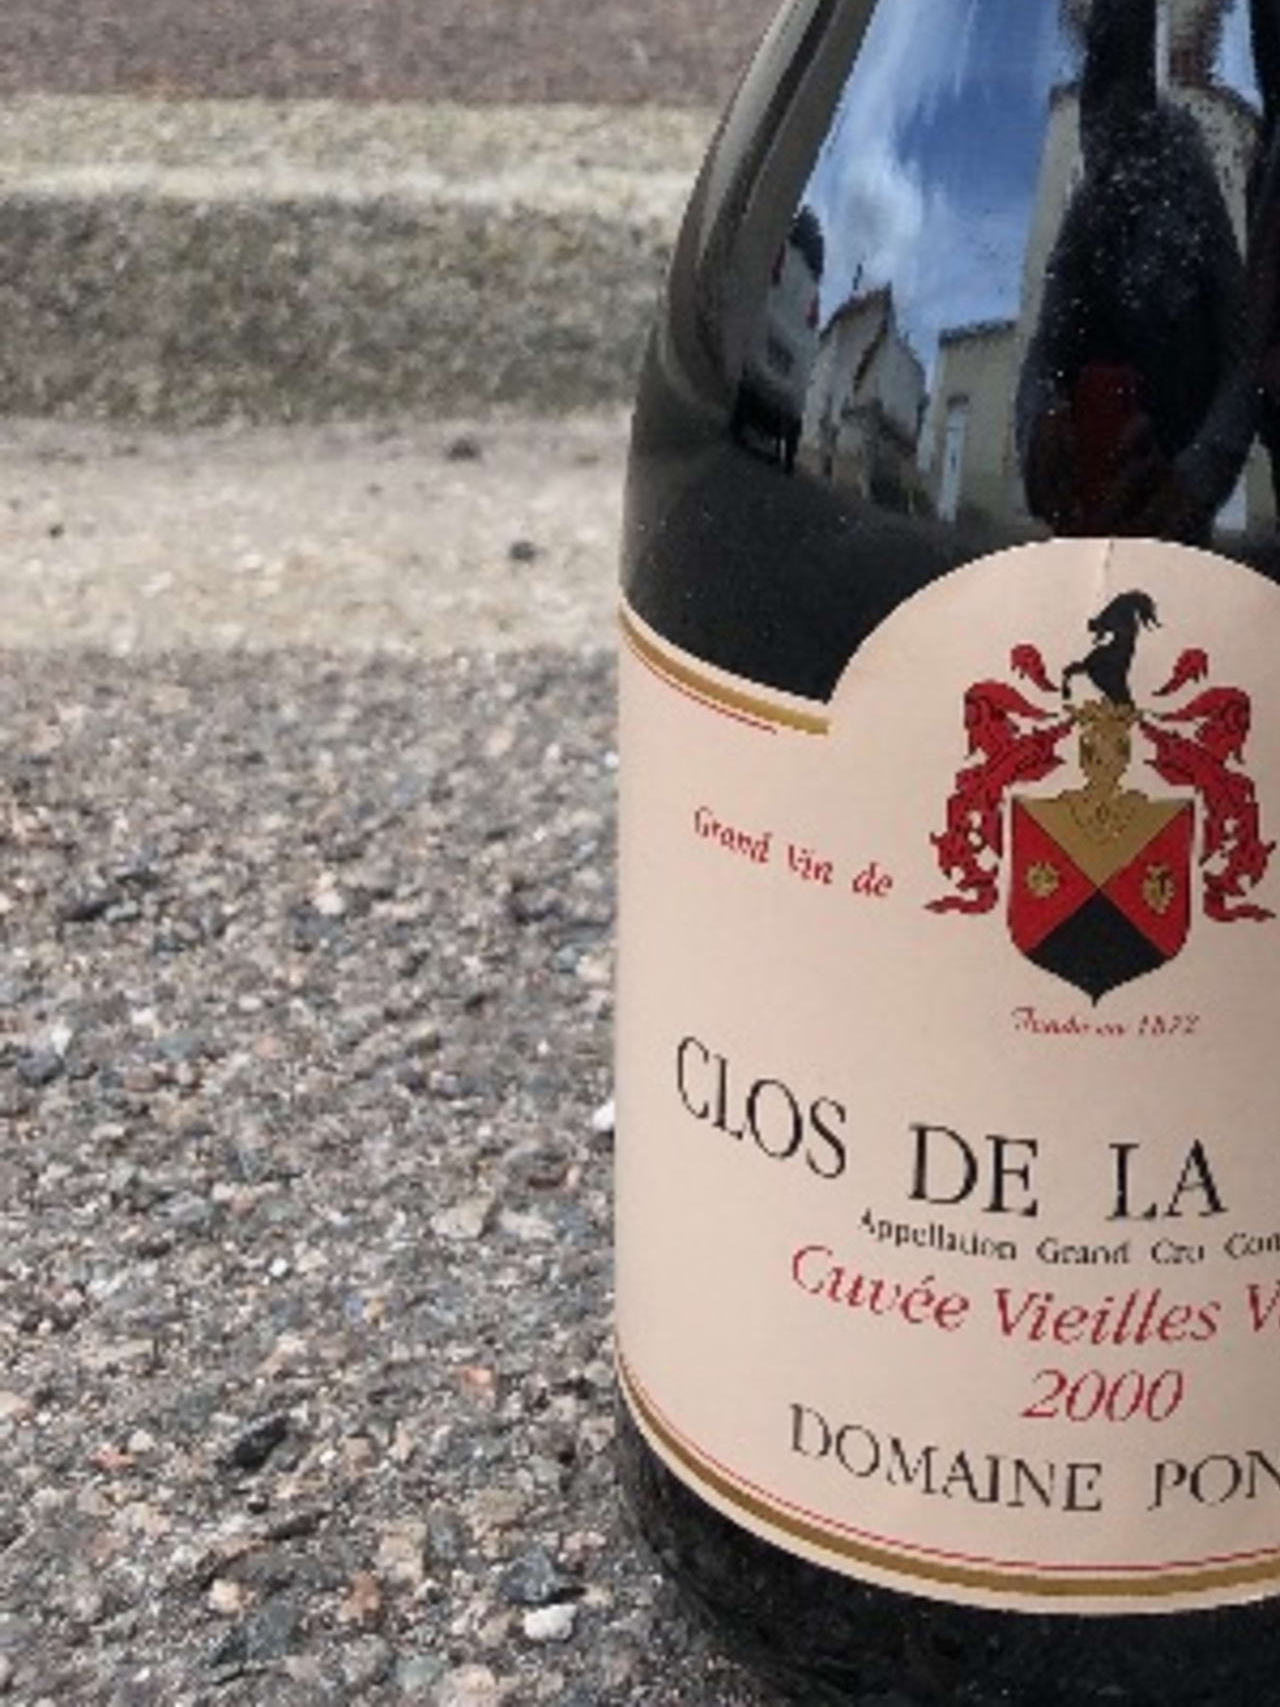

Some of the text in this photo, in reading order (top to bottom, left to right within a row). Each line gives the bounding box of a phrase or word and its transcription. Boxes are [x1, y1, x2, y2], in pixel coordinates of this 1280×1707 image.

[851, 861, 894, 898] de
[676, 1035, 847, 1180] CLOS
[908, 1122, 1039, 1218] DE
[1106, 1139, 1229, 1221] LA
[859, 1207, 1018, 1261] Appellation
[1036, 1237, 1131, 1265] Grand
[1150, 1237, 1205, 1265] Cru
[792, 1244, 971, 1332] Cuvée
[994, 1287, 1221, 1346] Vieilles
[1020, 1368, 1185, 1423] 2000
[789, 1402, 1103, 1512] DOMAINE
